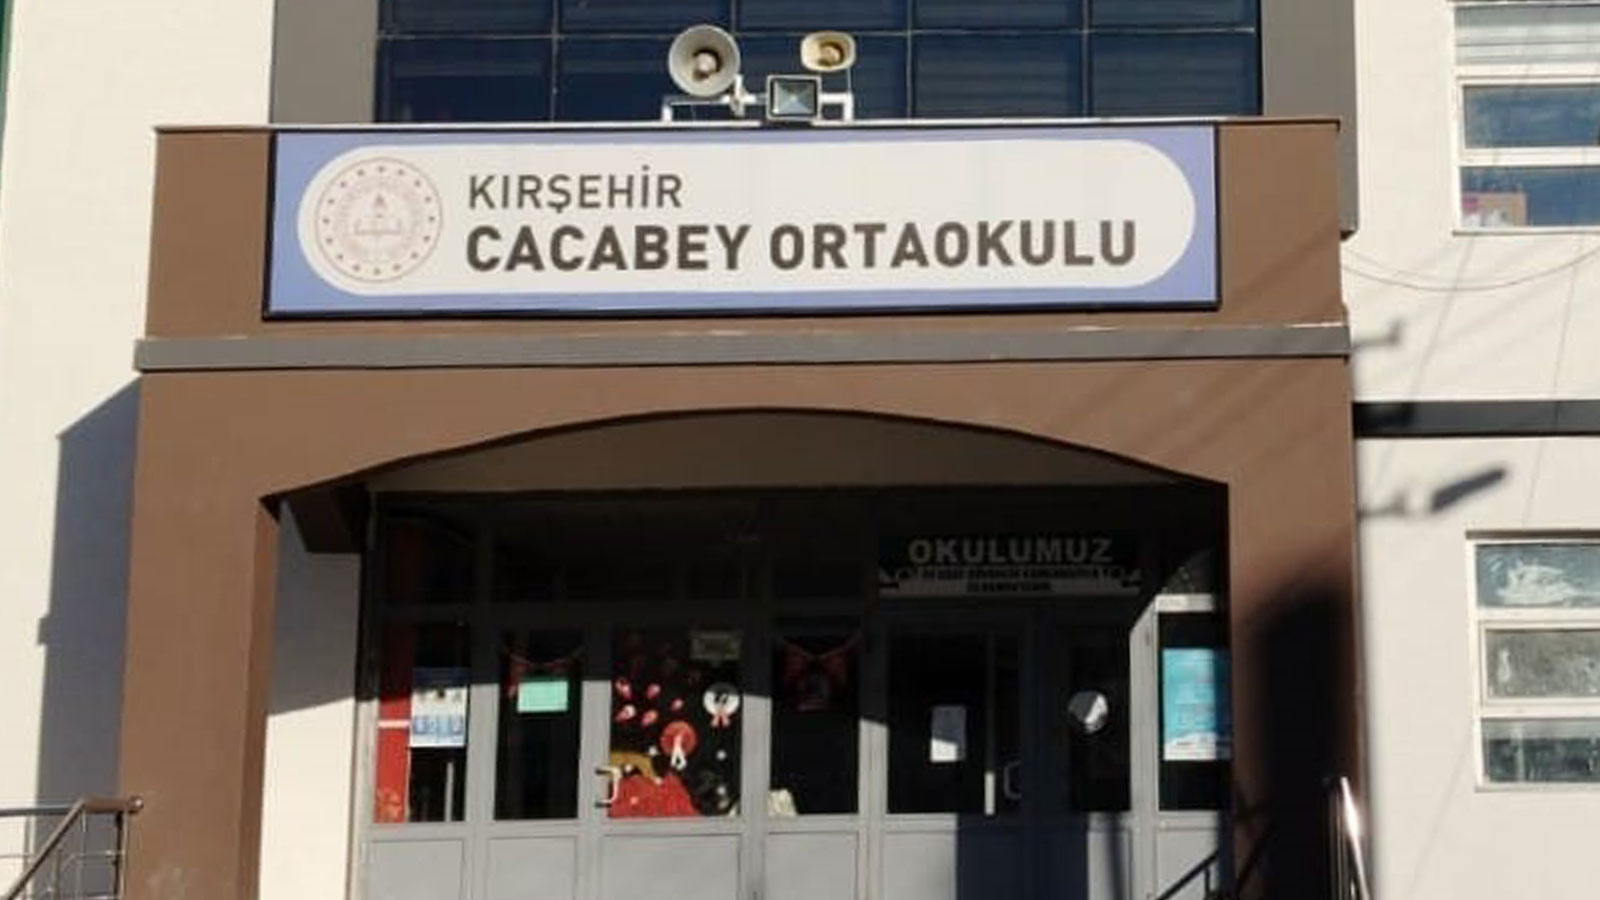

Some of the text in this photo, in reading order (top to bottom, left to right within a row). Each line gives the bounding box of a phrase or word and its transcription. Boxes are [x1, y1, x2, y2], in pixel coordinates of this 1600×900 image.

[468, 164, 683, 214] KIRŞEHİR
[465, 219, 1137, 272] CACABEY ORTAOKULU
[907, 537, 1113, 564] OKULUMUZ
